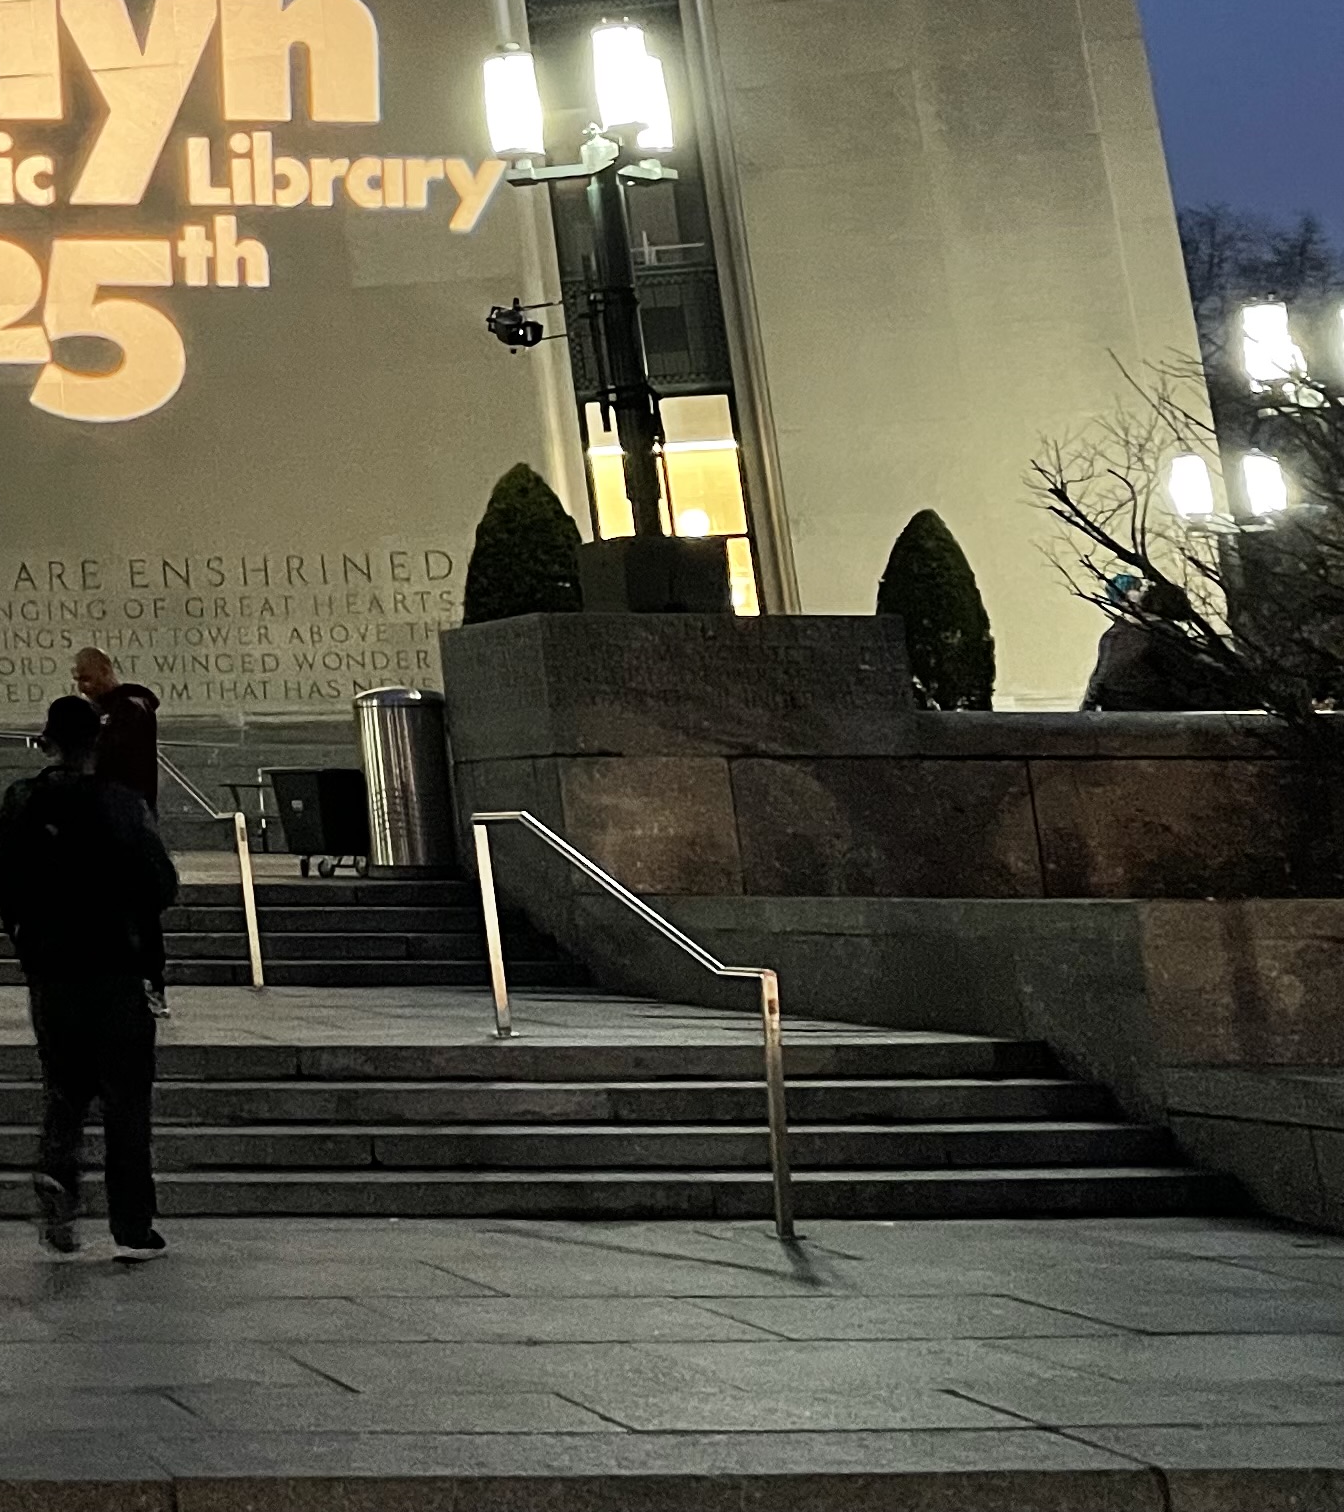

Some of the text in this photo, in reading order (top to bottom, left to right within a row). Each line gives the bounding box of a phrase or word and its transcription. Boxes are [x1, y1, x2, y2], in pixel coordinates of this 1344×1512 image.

[187, 132, 508, 233] Library
[13, 558, 103, 592] ARE
[127, 549, 454, 589] ENSHRINED
[122, 596, 167, 620] OF
[184, 593, 295, 619] GREAT
[312, 589, 455, 617] HEARTS
[91, 625, 158, 648] THAT
[170, 624, 273, 647] TOWER
[288, 622, 388, 648] ABOVE
[112, 654, 141, 674] AT
[153, 652, 281, 674] WINGED
[292, 649, 431, 673] WONDER
[199, 679, 269, 701] THAT
[282, 678, 343, 700] HAS
